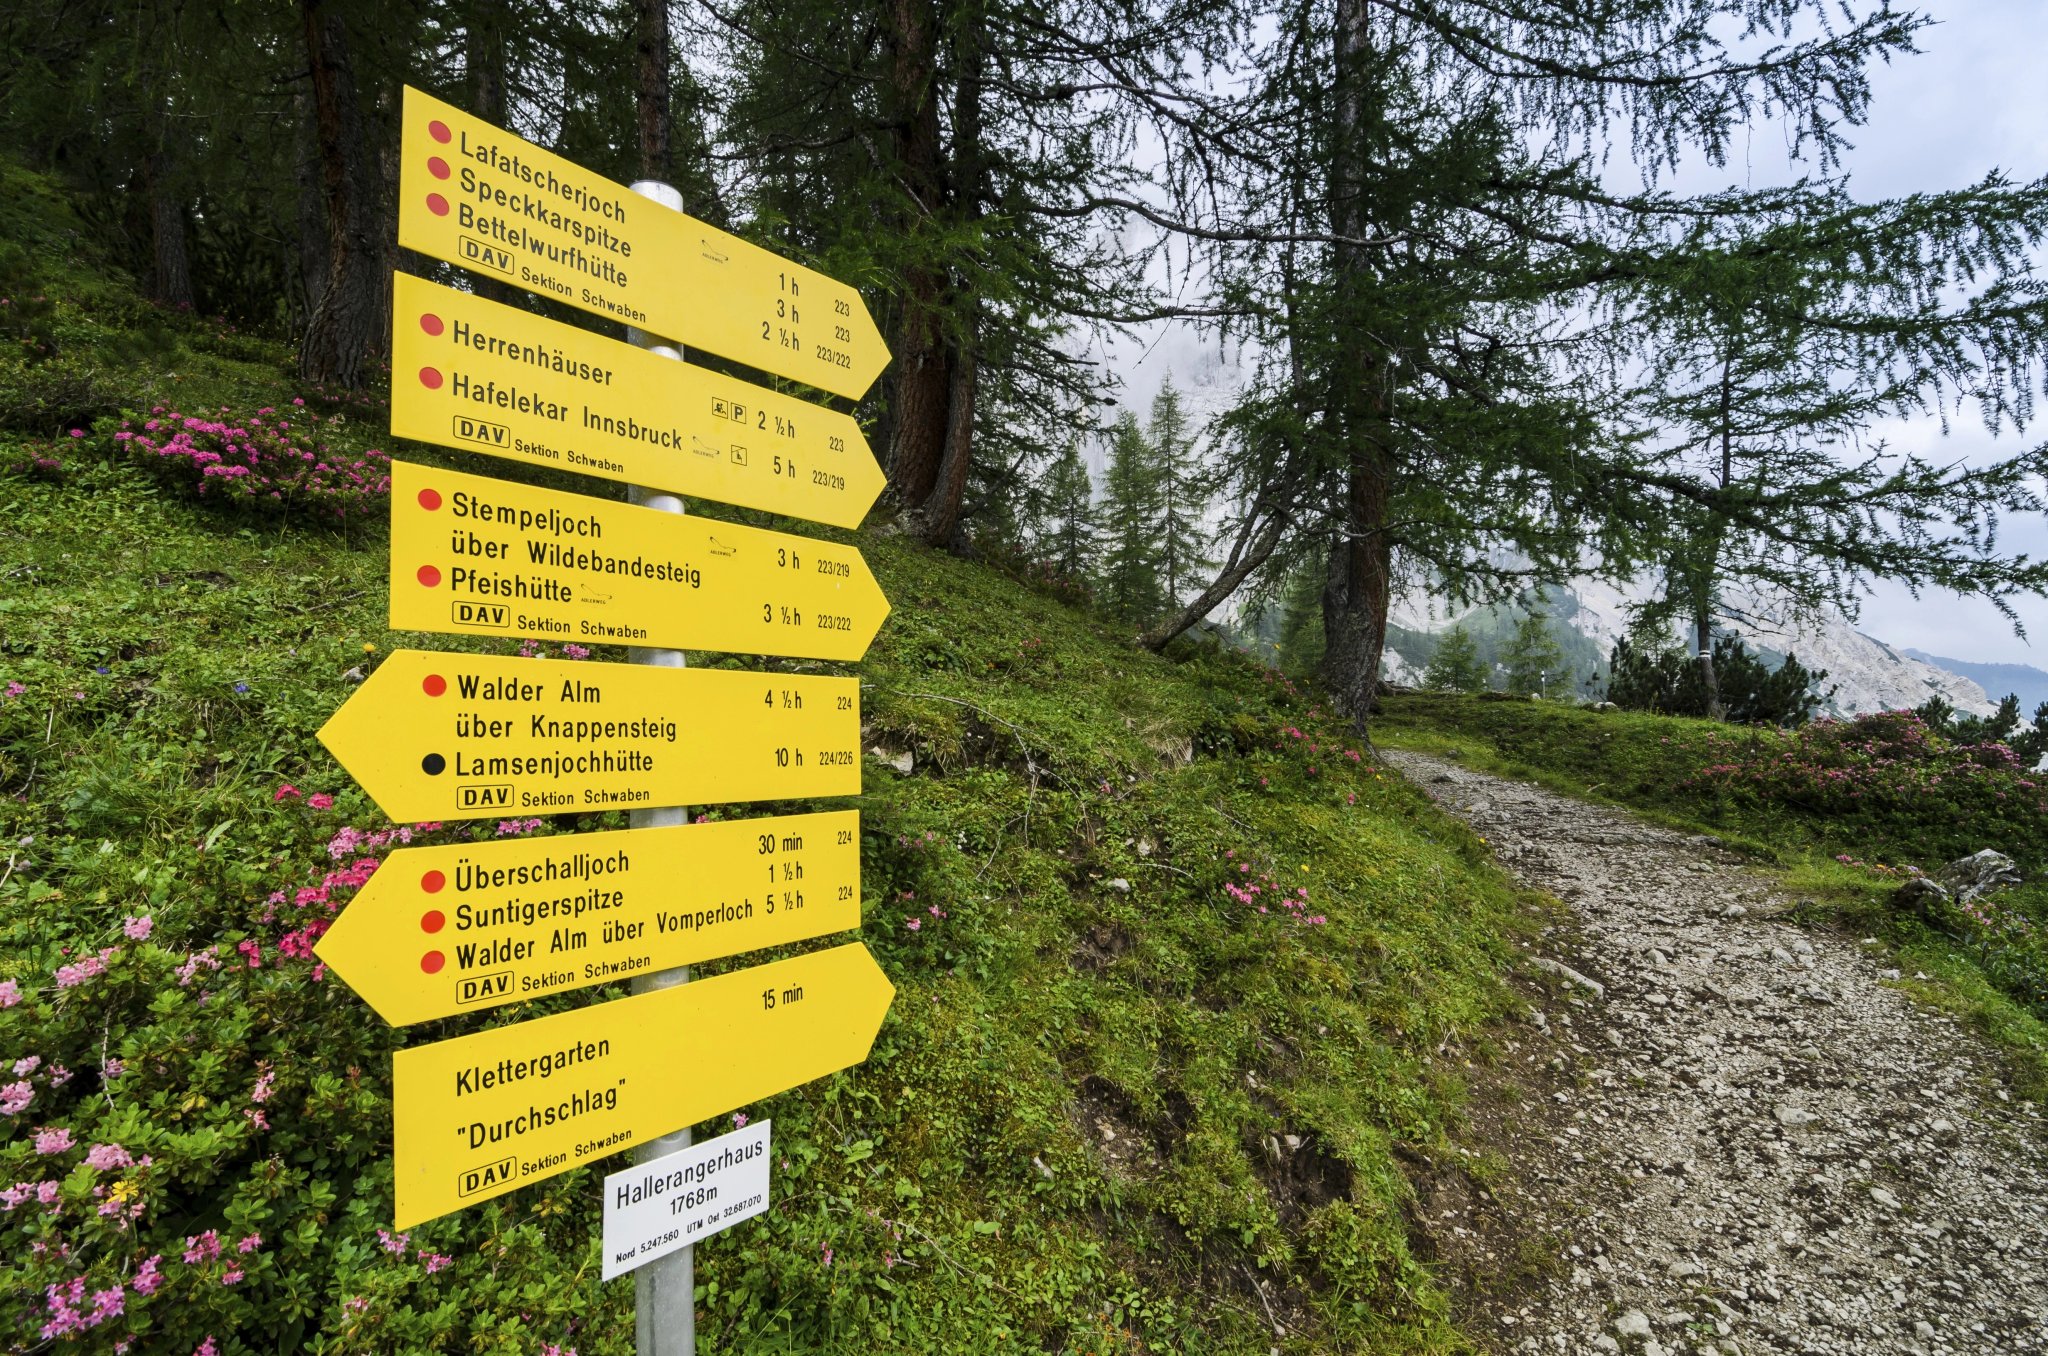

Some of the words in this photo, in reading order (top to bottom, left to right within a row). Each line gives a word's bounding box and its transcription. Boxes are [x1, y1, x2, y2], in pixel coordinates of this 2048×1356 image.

[461, 132, 625, 223] Lafatscherjoch
[460, 169, 631, 257] Speckkarspitze
[459, 206, 627, 288] Bettelwurfhütte
[466, 242, 508, 268] DAV
[521, 268, 572, 296] Sektion
[582, 289, 646, 323] Schwaben
[778, 273, 785, 290] 1
[792, 278, 798, 296] h
[777, 300, 785, 317] 3
[792, 305, 799, 324] h
[835, 300, 850, 316] 223
[762, 322, 770, 340] 2
[792, 333, 800, 351] h
[835, 326, 850, 343] 223
[454, 321, 612, 386] Herrenhäuser
[816, 346, 851, 370] 223/222
[453, 373, 568, 422] Hafelekar
[584, 407, 682, 451] Innsbruck
[758, 411, 766, 429] 2
[787, 420, 795, 438] h
[460, 421, 504, 444] DAV
[514, 439, 559, 458] Sektion
[568, 451, 624, 473] Schwaben
[829, 436, 844, 453] 223
[773, 456, 781, 474] 5
[788, 460, 795, 479] h
[812, 470, 844, 491] 223/219
[452, 493, 601, 539] Stempeljoch
[452, 531, 508, 560] über
[528, 542, 701, 589] Wildebandesteig
[778, 549, 785, 567] 3
[792, 552, 800, 571] h
[818, 559, 849, 578] 223/219
[452, 568, 572, 604] Pfeishütte
[459, 606, 504, 623] DAV
[518, 616, 571, 634] Sektion
[581, 622, 647, 641] Schwaben
[764, 605, 771, 624] 3
[794, 608, 800, 626] h
[817, 614, 851, 631] 223/222
[458, 675, 543, 701] Walder
[561, 680, 601, 703] Alm
[764, 690, 773, 709] 4
[794, 692, 801, 709] h
[837, 697, 852, 710] 224
[457, 714, 513, 738] über
[532, 716, 676, 742] Knappensteig
[457, 753, 653, 779] Lamsenjochhütte
[775, 748, 788, 767] 10
[795, 748, 802, 766] h
[819, 753, 853, 766] 224/226
[464, 789, 508, 805] DAV
[521, 791, 574, 807] Sektion
[584, 788, 649, 804] Schwaben
[758, 834, 775, 854] 30
[782, 832, 802, 852] min
[837, 831, 852, 845] 224
[456, 850, 629, 891] Überschalljoch
[768, 865, 774, 884] 1
[796, 861, 803, 880] h
[766, 895, 774, 915] 5
[796, 891, 803, 909] h
[838, 886, 852, 900] 224
[457, 888, 623, 931] Suntigerspitze
[457, 938, 534, 970] Walder
[551, 929, 587, 953] Alm
[603, 915, 644, 946] über
[657, 900, 752, 935] Vomperloch
[464, 976, 508, 1000] DAV
[521, 969, 575, 992] Sektion
[585, 954, 650, 979] Schwaben
[762, 990, 775, 1010] 15
[782, 984, 803, 1006] min
[457, 1037, 610, 1097] Klettergarten
[457, 1079, 626, 1150] "Durchschlag"
[467, 1162, 511, 1191] DAV
[521, 1151, 566, 1176] Sektion
[575, 1129, 632, 1157] Schwaben
[617, 1139, 763, 1209] Hallerangerhaus
[670, 1185, 718, 1216] 1768m
[616, 1248, 635, 1263] Nord
[640, 1228, 679, 1254] 5.247.560
[687, 1216, 703, 1233] UTM
[708, 1211, 719, 1224] Ost
[724, 1194, 762, 1218] 32.687.070
